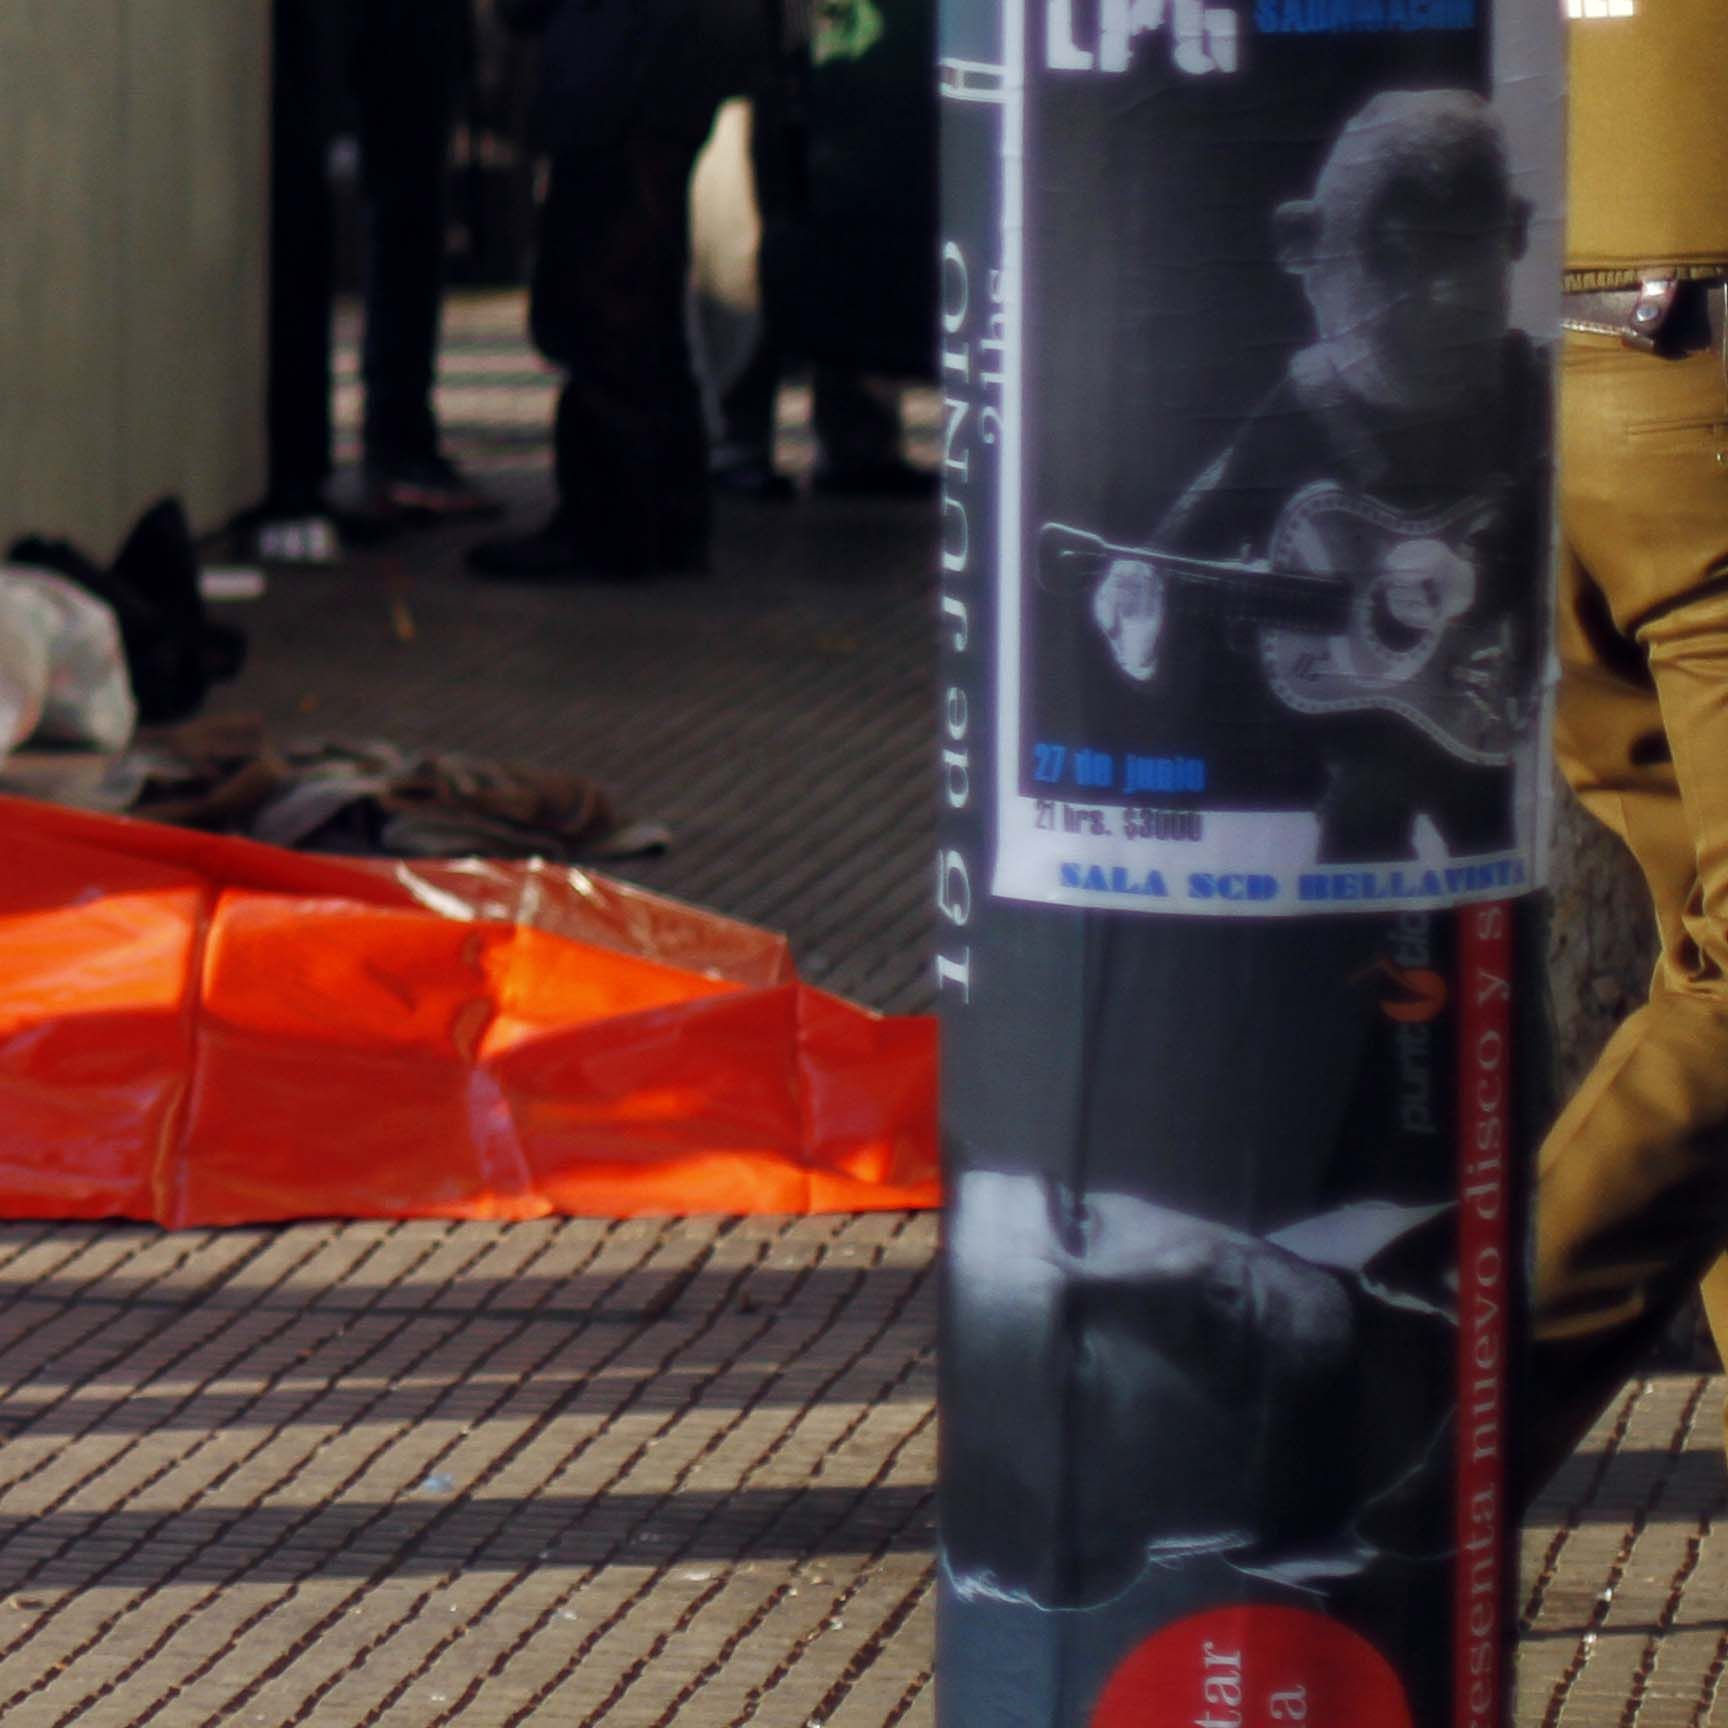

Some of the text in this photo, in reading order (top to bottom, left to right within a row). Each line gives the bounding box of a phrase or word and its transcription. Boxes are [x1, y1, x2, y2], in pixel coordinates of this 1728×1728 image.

[935, 240, 972, 1006] 15 de JUNIO
[1033, 742, 1066, 784] 27
[1058, 859, 1527, 901] SALA SCD BELLAVISTA
[1475, 967, 1511, 1007] y
[1465, 1029, 1504, 1219] disco
[1470, 1245, 1502, 1463] nuevo
[1194, 1640, 1243, 1728] tar
